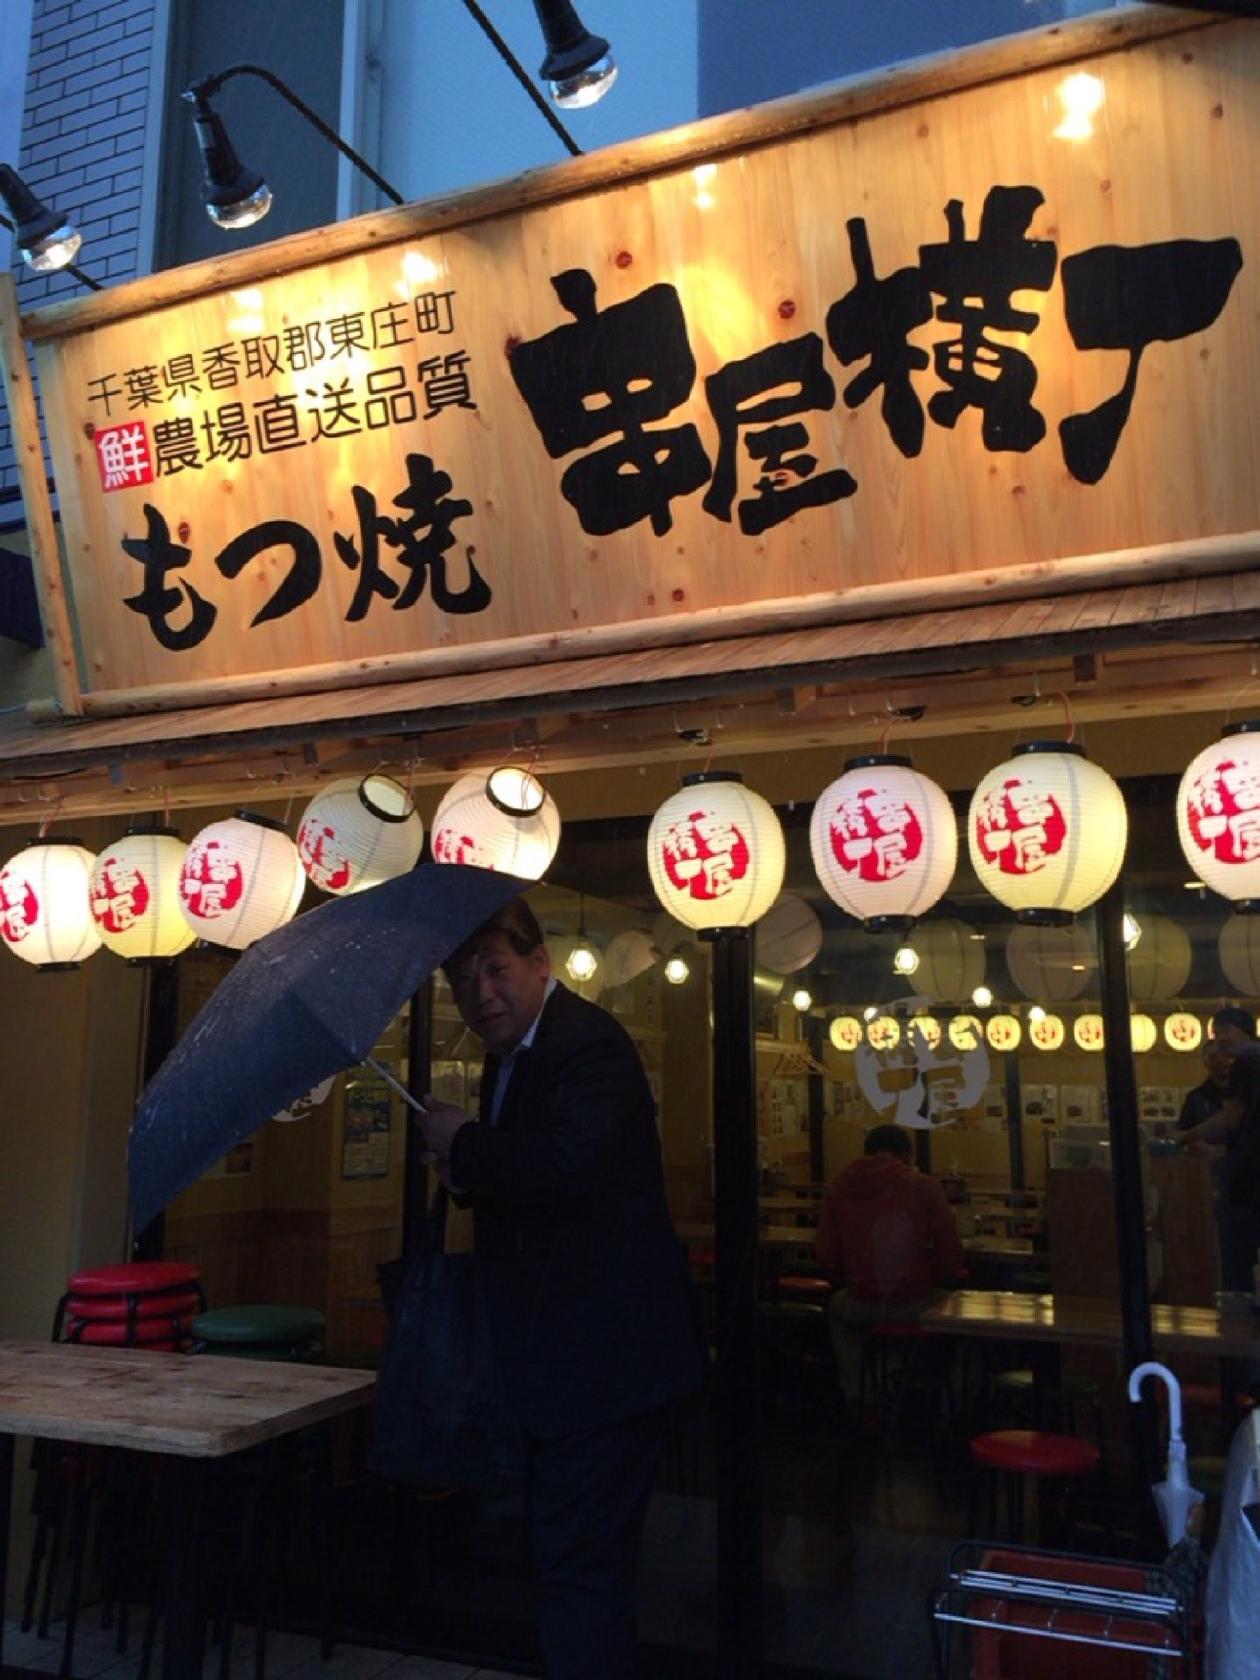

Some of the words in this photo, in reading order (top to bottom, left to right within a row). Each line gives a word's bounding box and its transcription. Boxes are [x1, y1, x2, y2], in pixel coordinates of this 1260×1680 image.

[88, 291, 458, 417] 千葉県香取郡東庄町
[153, 350, 477, 477] 農場直送品質
[508, 185, 1243, 536] 串屋横丁
[98, 426, 150, 487] 鮮
[121, 453, 492, 651] もつ焼
